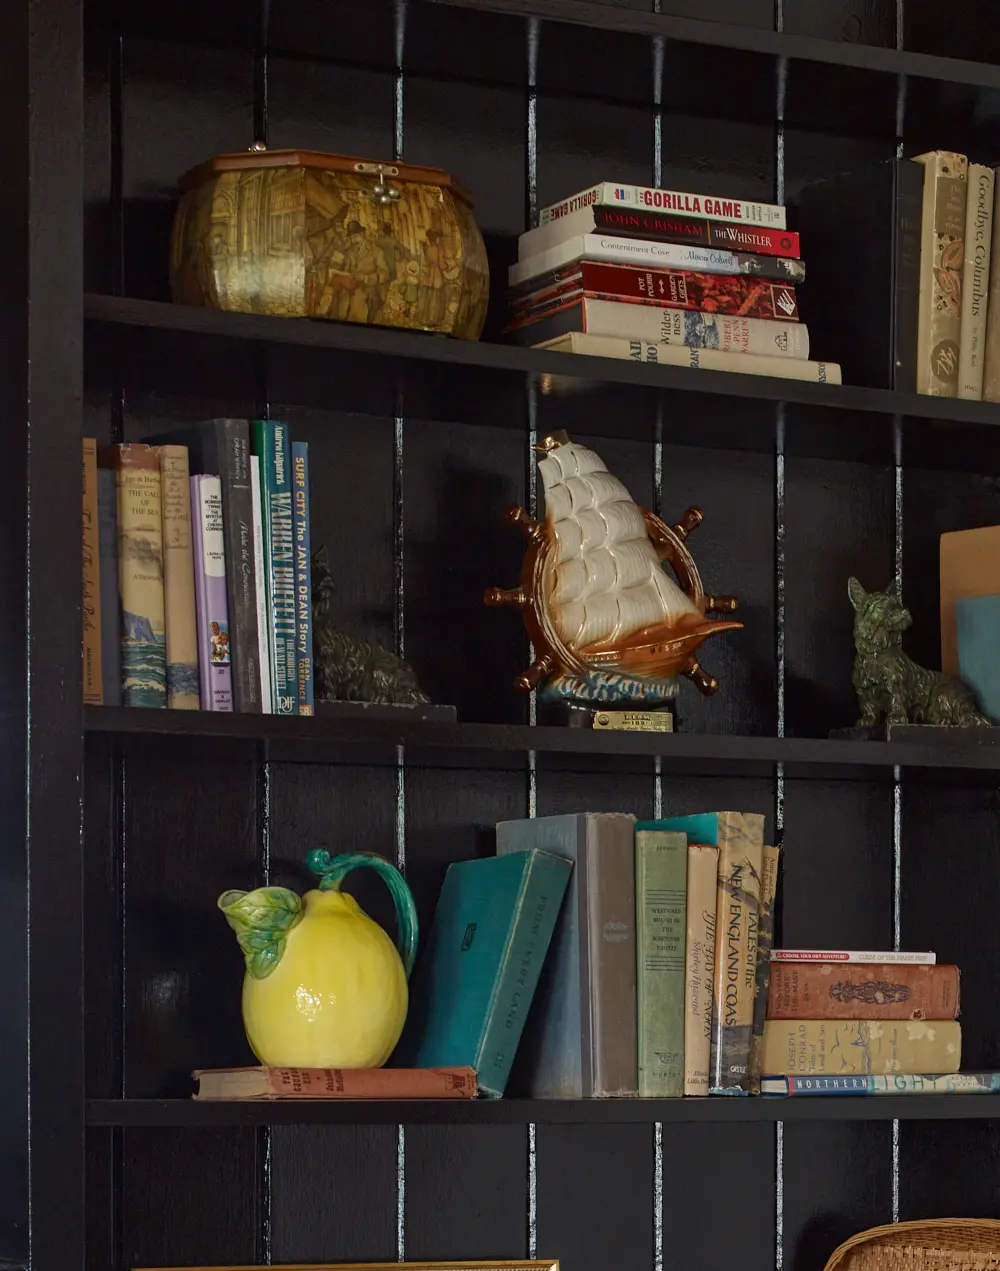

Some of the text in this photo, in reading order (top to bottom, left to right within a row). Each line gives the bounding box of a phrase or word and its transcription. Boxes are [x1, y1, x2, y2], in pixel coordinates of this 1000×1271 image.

[644, 190, 701, 214] GORILLA
[704, 198, 742, 218] GAME
[604, 212, 703, 236] JOHN GRISHAM
[600, 240, 671, 257] Contentment Cove
[714, 228, 772, 248] THE WHISTLER
[972, 174, 990, 317] Goodbye, Columbus
[638, 276, 646, 291] POT
[646, 273, 655, 297] POURRI
[669, 275, 678, 302] GARDEN
[678, 280, 686, 299] GIFTS
[673, 313, 681, 336] ness
[274, 425, 283, 452] Andrew
[296, 457, 304, 487] SURF
[128, 490, 142, 498] THE
[296, 490, 306, 516] CITY
[239, 520, 248, 546] Make
[297, 520, 306, 542] The
[242, 549, 250, 562] the
[271, 492, 296, 634] WARREN BUFFETT
[298, 545, 306, 570] JAN
[298, 586, 308, 620] DEAN
[298, 623, 308, 653] Story
[728, 864, 743, 982] NEW ENGLAND
[504, 894, 548, 1030] FROM EVERY LAND
[746, 912, 758, 989] TALES of the
[690, 940, 701, 1016] Shirley Hazzard
[702, 910, 716, 1040] THE BAY OF NOON
[788, 1032, 796, 1072] JOSEPH
[798, 1024, 806, 1072] CONRAD
[730, 1065, 746, 1074] CASTLE
[796, 1080, 868, 1089] NORTHERN
